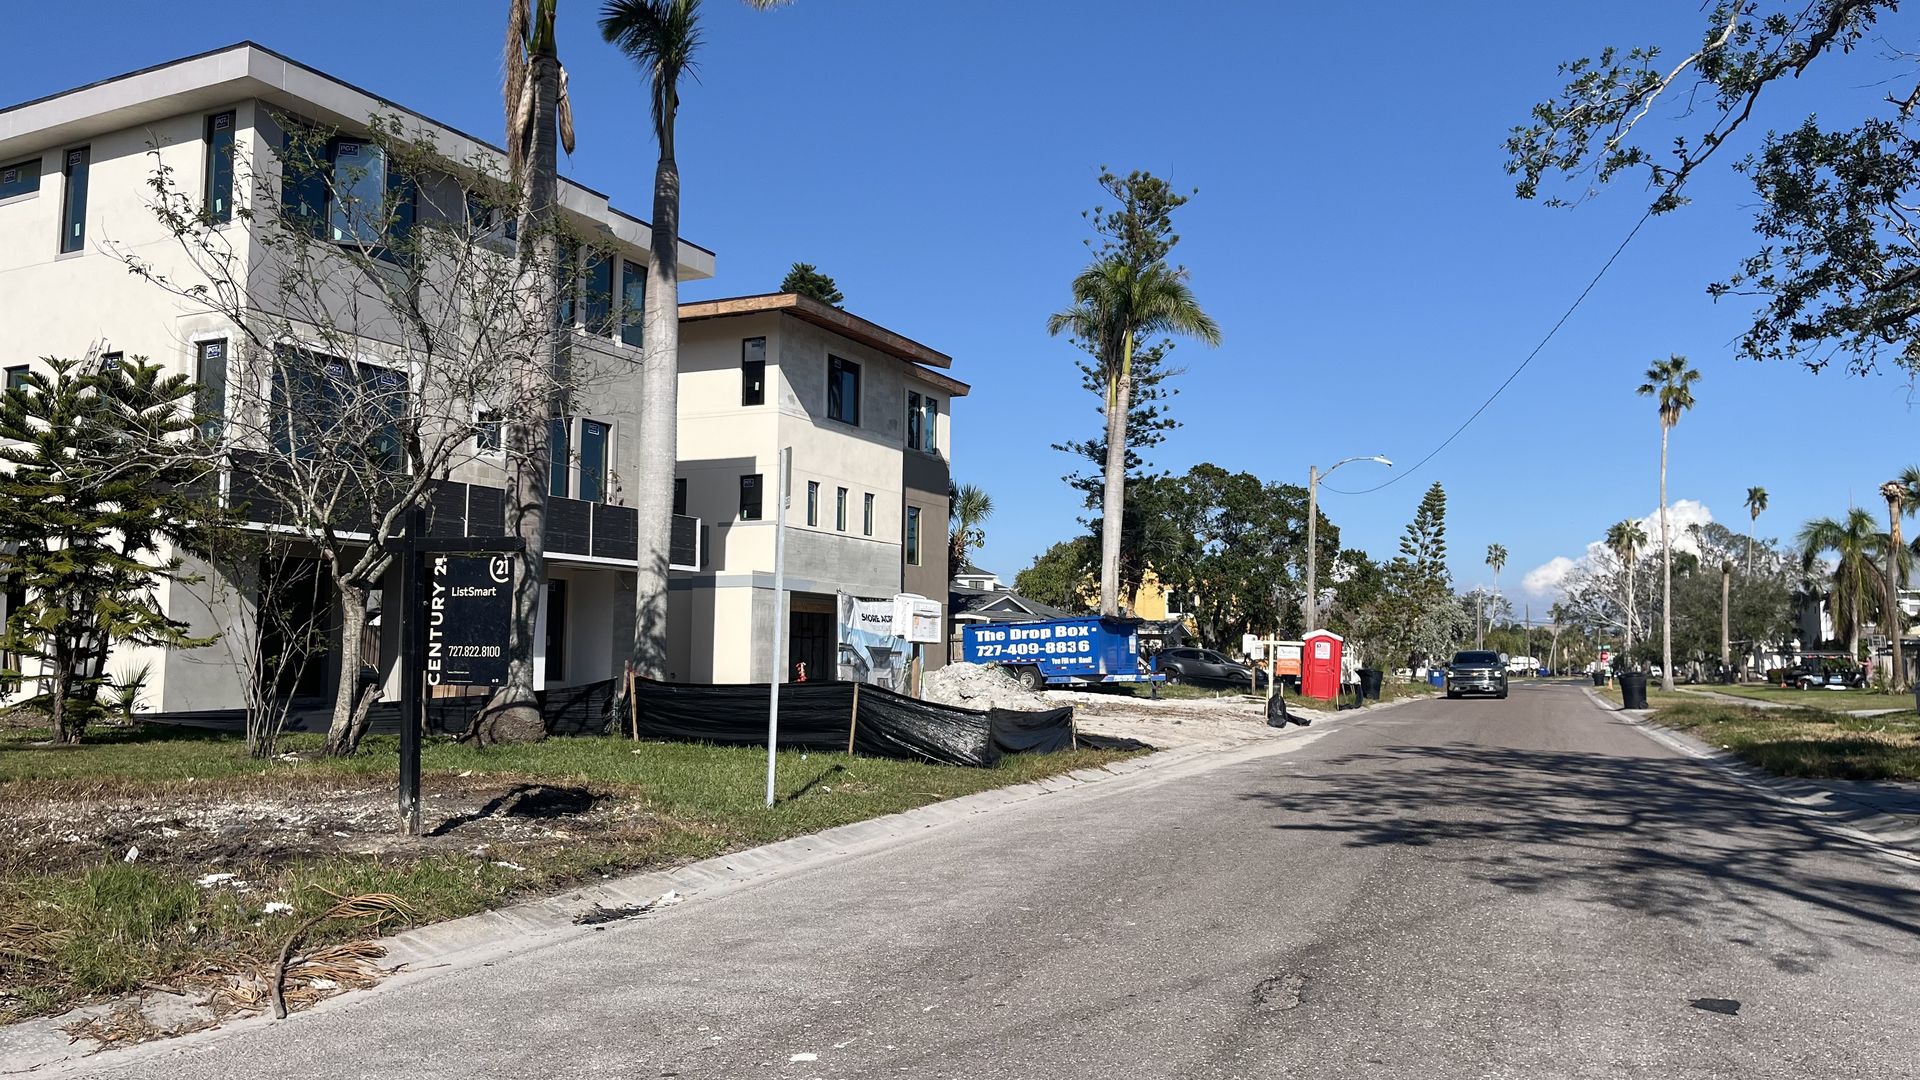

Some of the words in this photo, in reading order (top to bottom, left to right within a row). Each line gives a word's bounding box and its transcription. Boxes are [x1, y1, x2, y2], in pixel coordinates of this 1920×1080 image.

[496, 559, 509, 575] 21
[451, 586, 497, 597] ListSmart
[427, 581, 446, 686] CENTURY
[975, 630, 1006, 642] The
[1009, 627, 1052, 640] Drop
[1055, 625, 1089, 638] Box
[448, 645, 501, 658] 727.822.8100
[975, 639, 1090, 657] 727-409-8836
